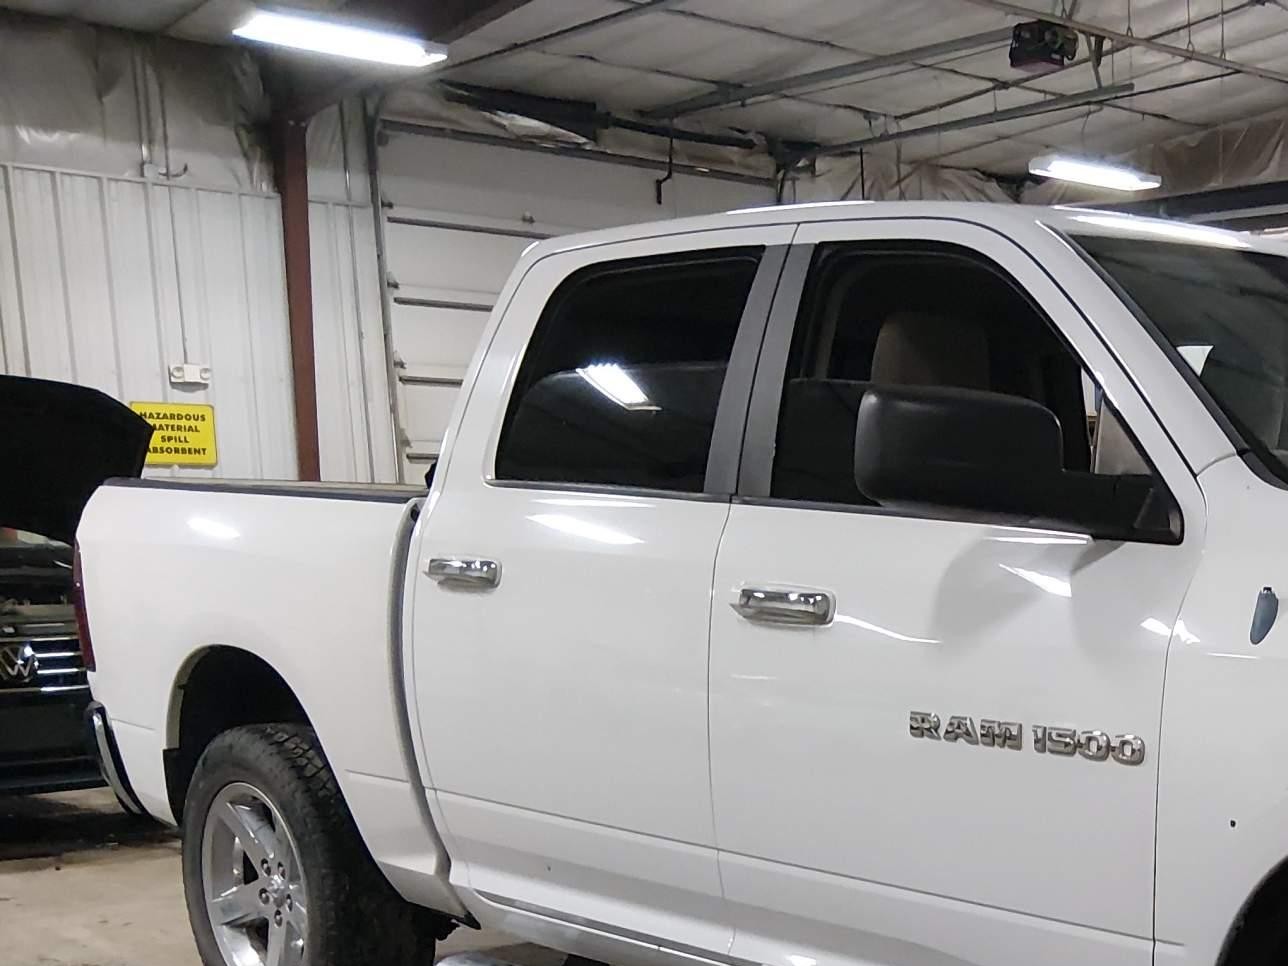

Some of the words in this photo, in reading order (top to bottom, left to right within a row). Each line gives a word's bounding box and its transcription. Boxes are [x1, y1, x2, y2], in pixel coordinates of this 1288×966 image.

[140, 411, 206, 422] HAZARDOUS
[160, 435, 189, 443] SPILL
[909, 710, 1023, 751] RAM
[1032, 724, 1146, 766] 1500
